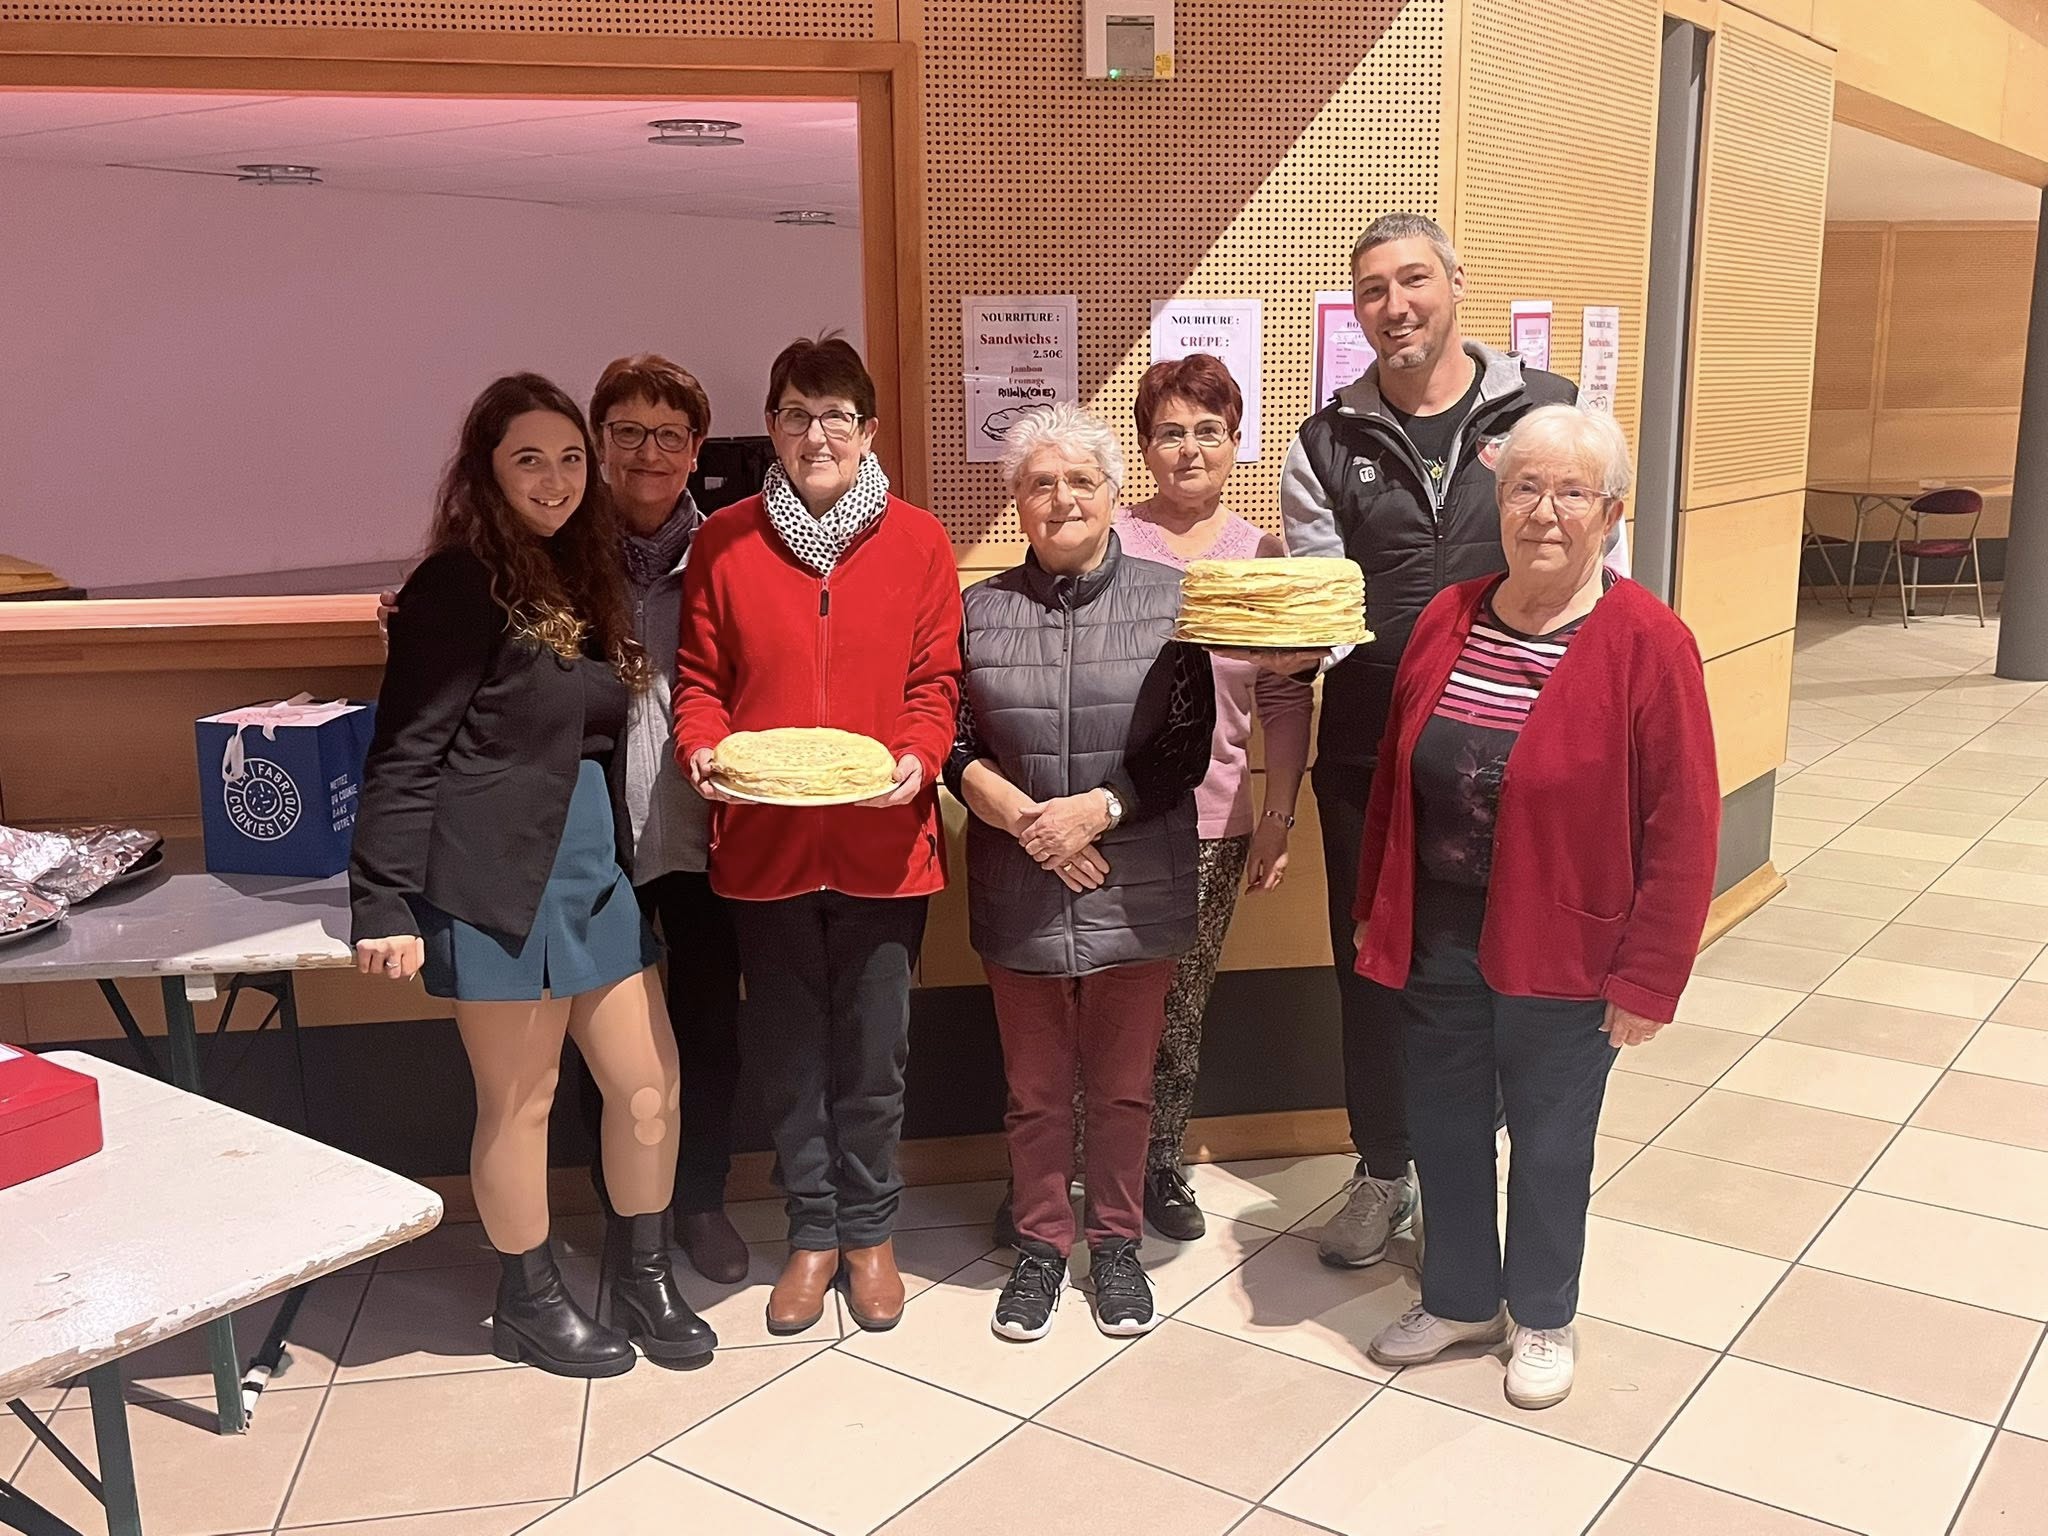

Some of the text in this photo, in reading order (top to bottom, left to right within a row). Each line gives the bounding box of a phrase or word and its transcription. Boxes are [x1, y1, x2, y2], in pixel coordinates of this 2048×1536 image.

[981, 313, 1054, 322] NOURRITURE
[1172, 316, 1233, 325] NOURITURE
[980, 334, 1051, 345] Sandwichs
[1033, 349, 1063, 358] 2.50€
[258, 763, 297, 826] FABRIQUE
[229, 796, 275, 836] COOKIES
[332, 803, 347, 818] DANS
